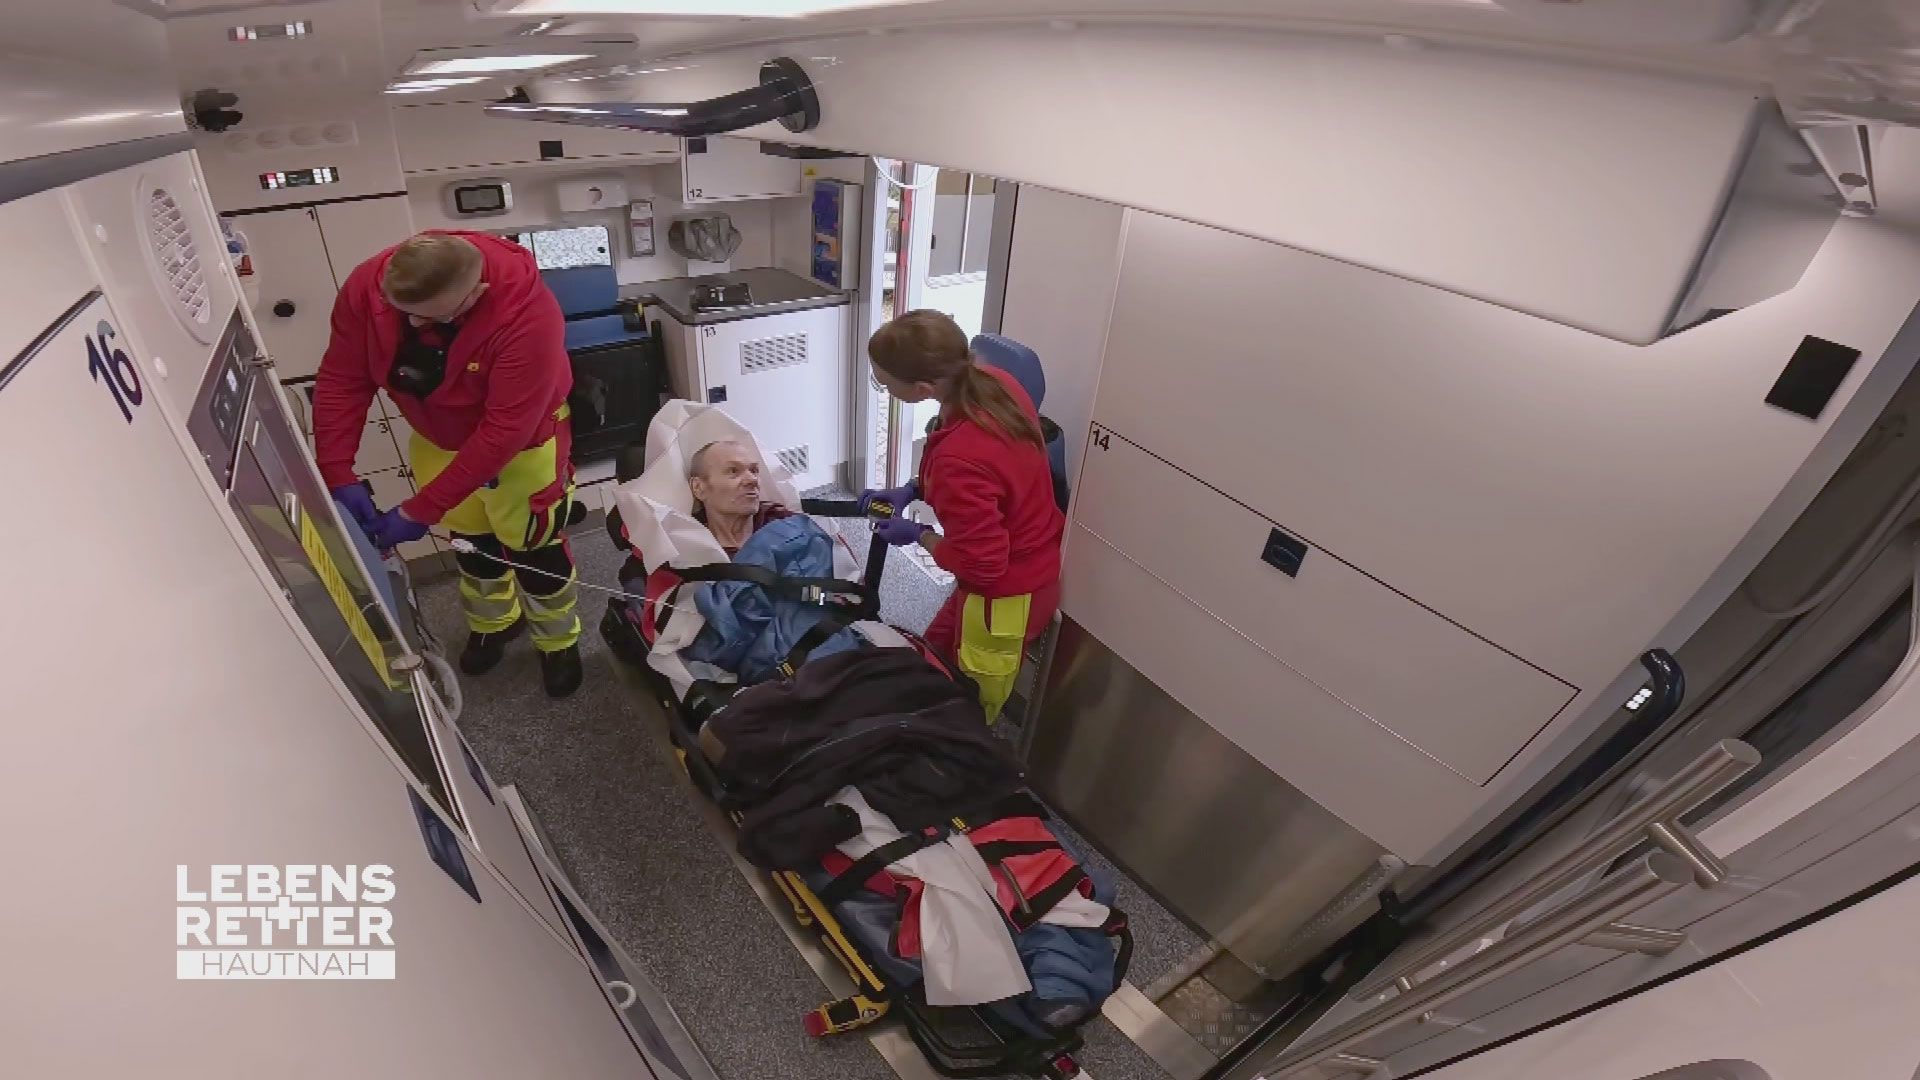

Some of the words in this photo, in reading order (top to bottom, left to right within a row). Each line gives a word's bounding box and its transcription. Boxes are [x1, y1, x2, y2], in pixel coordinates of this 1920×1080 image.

[689, 188, 703, 198] 12
[85, 319, 143, 425] 16
[378, 422, 389, 434] 3
[1093, 429, 1110, 452] 14
